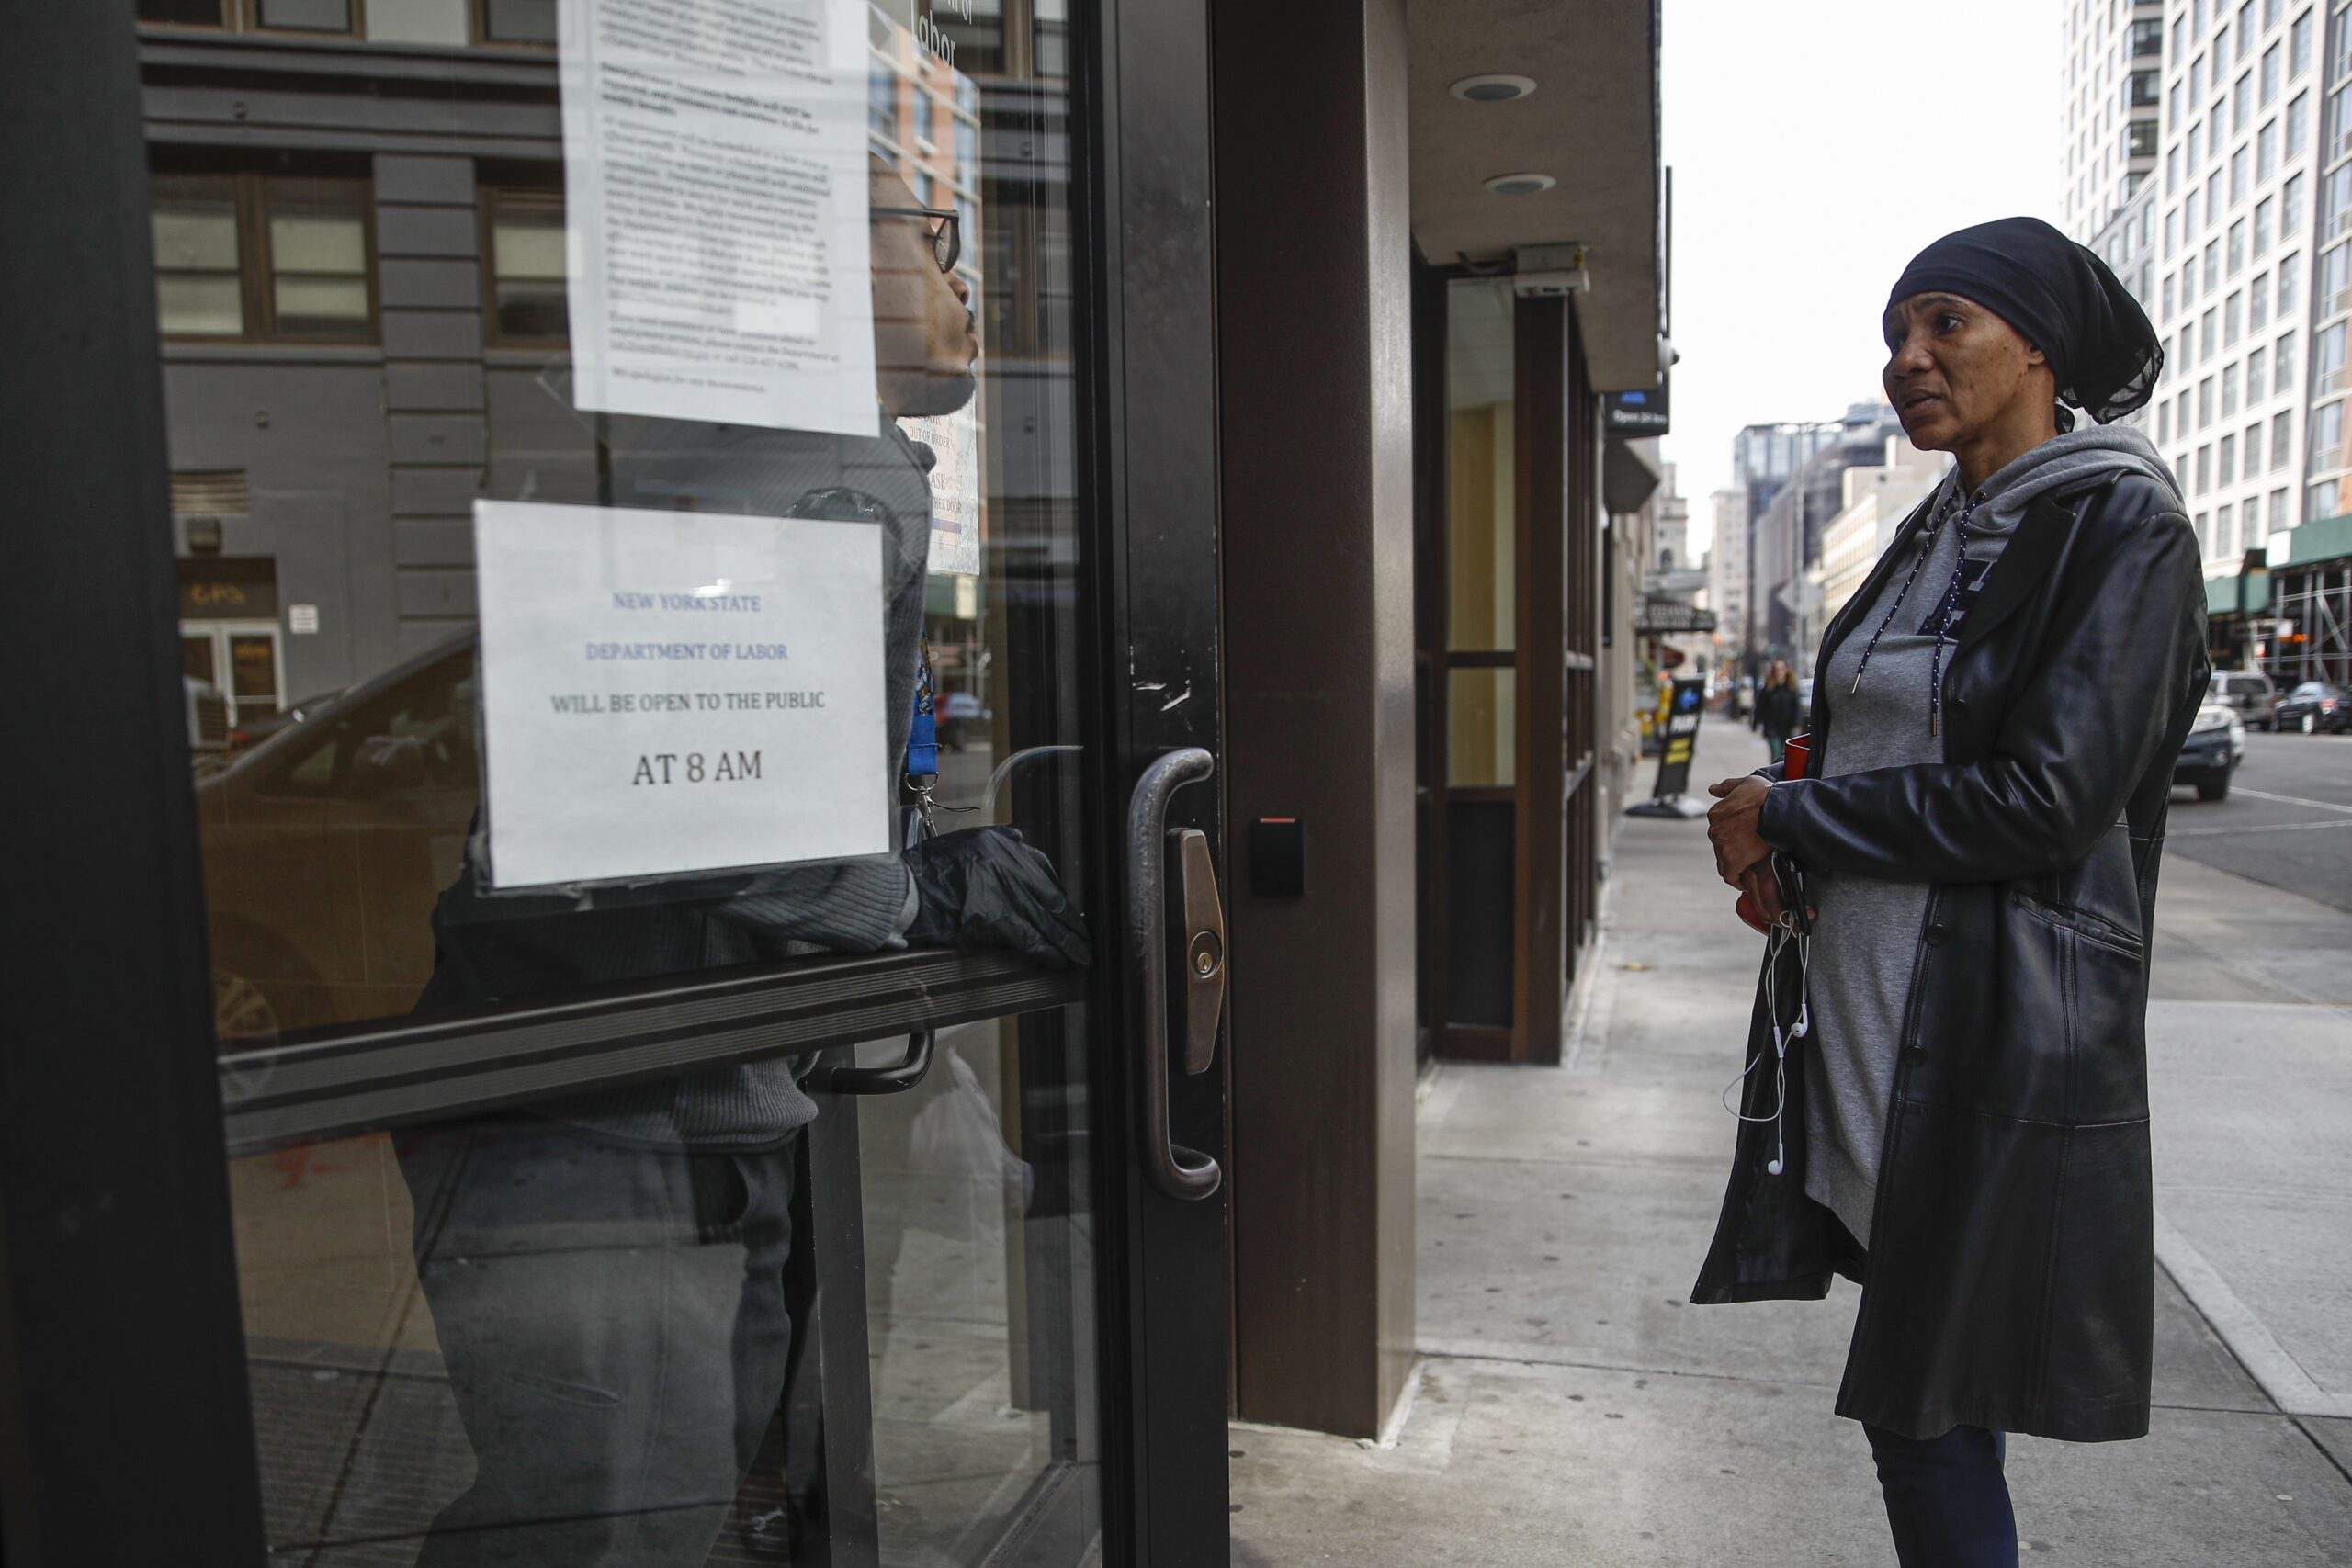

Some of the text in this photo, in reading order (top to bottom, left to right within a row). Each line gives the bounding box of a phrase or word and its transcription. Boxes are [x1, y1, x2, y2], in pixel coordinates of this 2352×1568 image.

[910, 426, 922, 439] OUT
[922, 429, 930, 443] OF
[613, 592, 762, 612] NEW YORK STATE
[585, 643, 788, 661] DEPARTMENT OF LABOR
[551, 691, 825, 714] WILL BE OPEN TO THE PUBLIC
[631, 750, 763, 786] AT 8 AM
